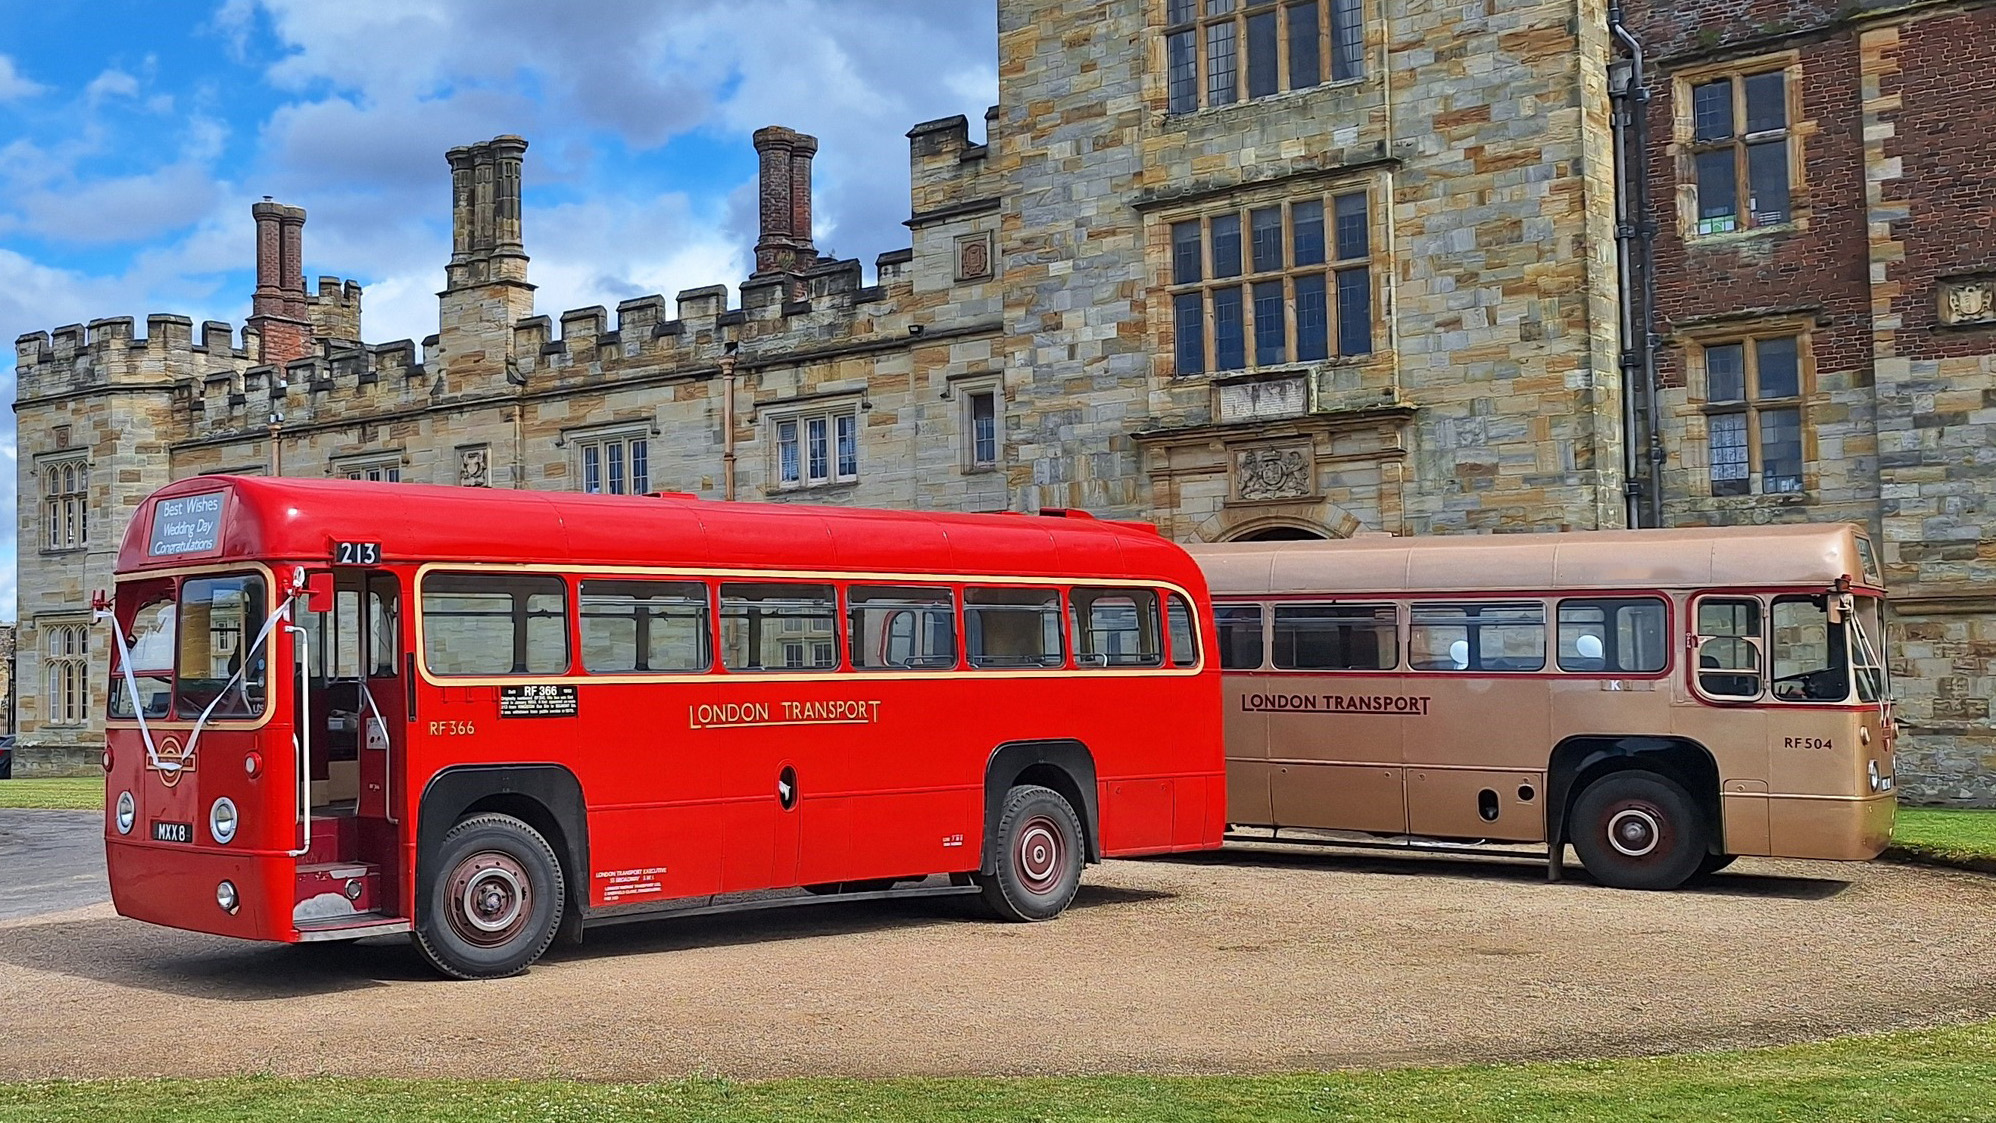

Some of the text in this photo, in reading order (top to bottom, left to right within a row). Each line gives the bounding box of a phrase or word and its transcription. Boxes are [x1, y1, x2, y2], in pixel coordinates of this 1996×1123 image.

[163, 496, 218, 517] Best Wishes
[163, 518, 214, 538] Wedding Day
[154, 538, 213, 555] Congratulations
[341, 542, 376, 564] 213
[1611, 680, 1621, 690] K
[689, 700, 881, 729] LONDON TRANSPORT
[1241, 693, 1431, 715] LONDON TRANSPORT
